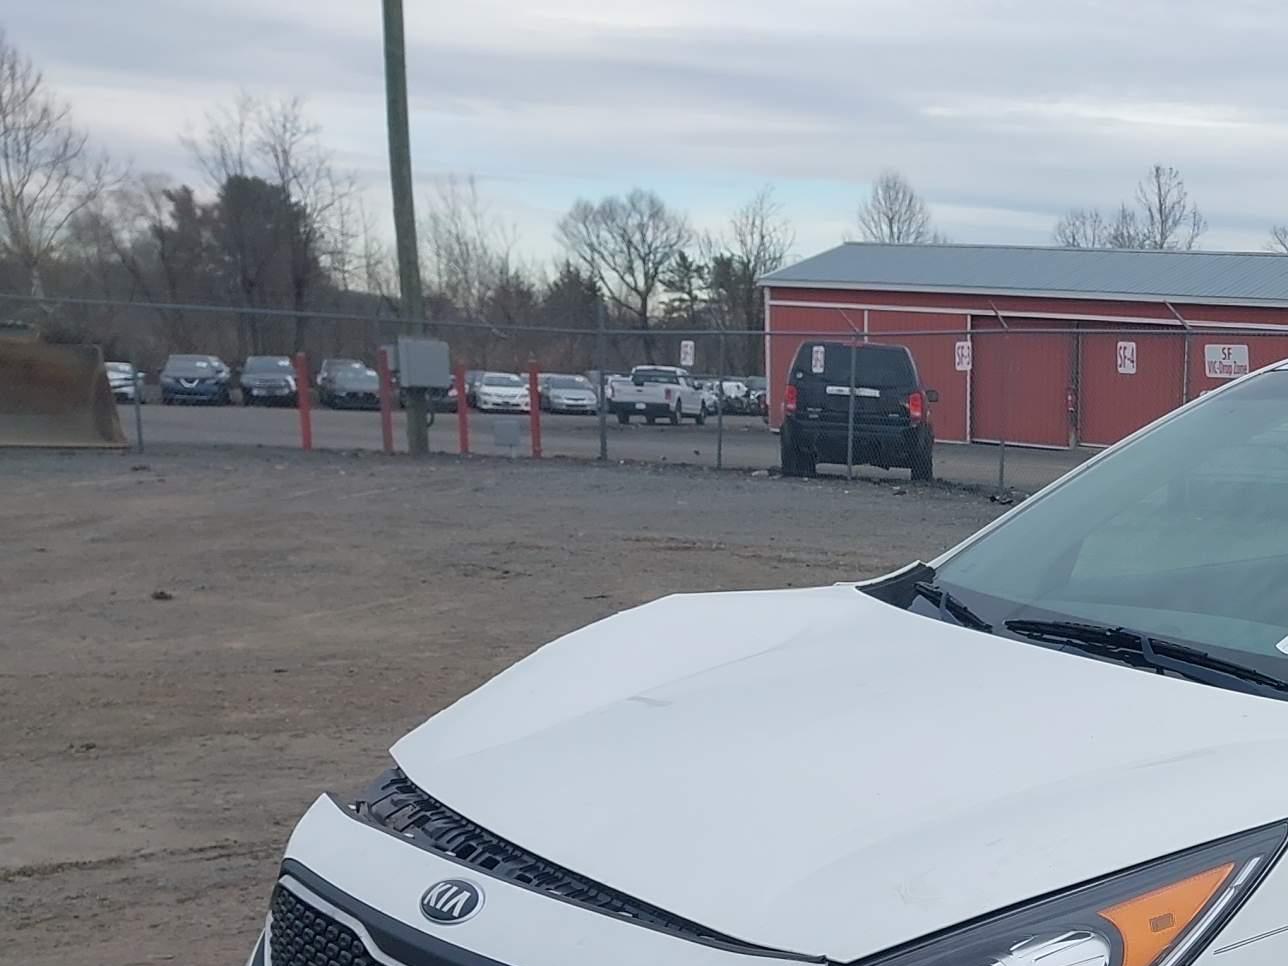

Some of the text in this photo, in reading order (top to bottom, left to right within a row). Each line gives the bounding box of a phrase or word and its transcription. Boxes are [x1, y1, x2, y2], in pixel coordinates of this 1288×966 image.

[1119, 346, 1135, 369] SF-4
[1221, 347, 1232, 361] SF
[423, 882, 471, 918] KIA
